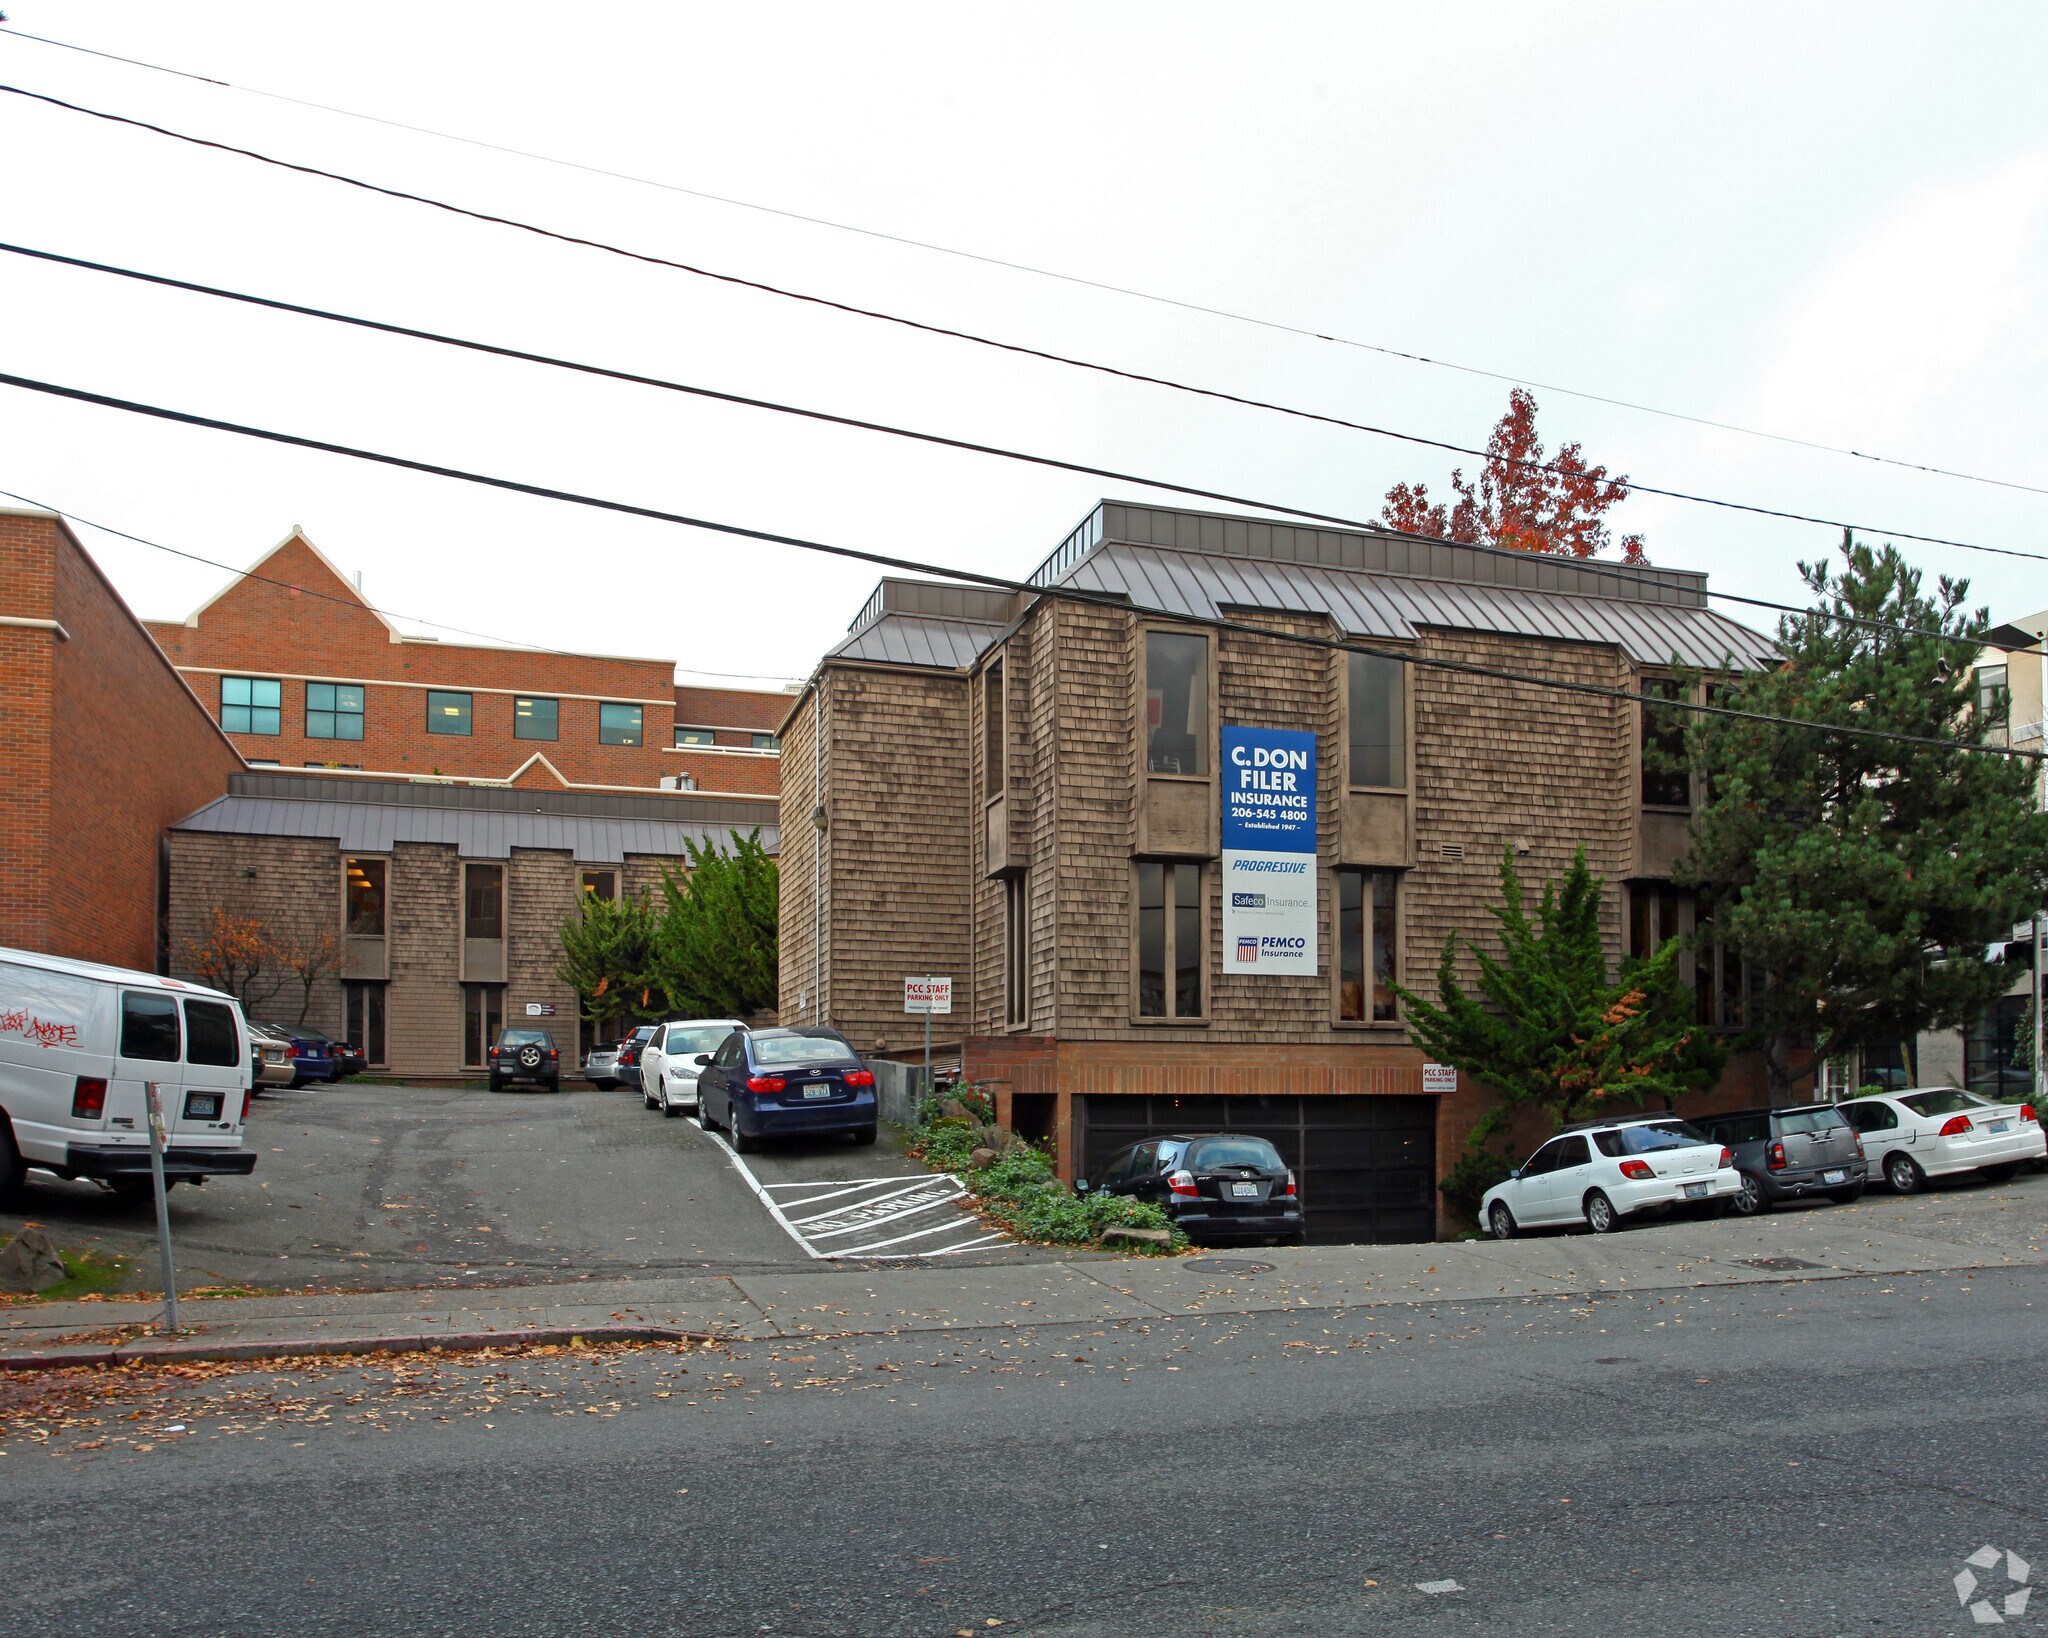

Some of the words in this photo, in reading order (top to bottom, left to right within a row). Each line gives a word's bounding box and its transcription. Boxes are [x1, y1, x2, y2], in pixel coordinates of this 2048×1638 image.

[1240, 769, 1297, 791] FILER
[1231, 791, 1308, 808] INSURANCE
[1231, 807, 1277, 819] 206-545
[1280, 810, 1308, 821] 4800
[1244, 821, 1280, 830] Established
[1232, 859, 1308, 874] PROGRESSIVE
[1234, 895, 1264, 907] Safeco
[1267, 896, 1308, 908] Insurance
[1261, 936, 1306, 949] PEMCO
[1261, 948, 1304, 958] Insurance
[907, 984, 924, 993] PCC
[926, 984, 950, 994] STAFF
[798, 1219, 848, 1232] NO
[851, 1189, 952, 1220] PARKING
